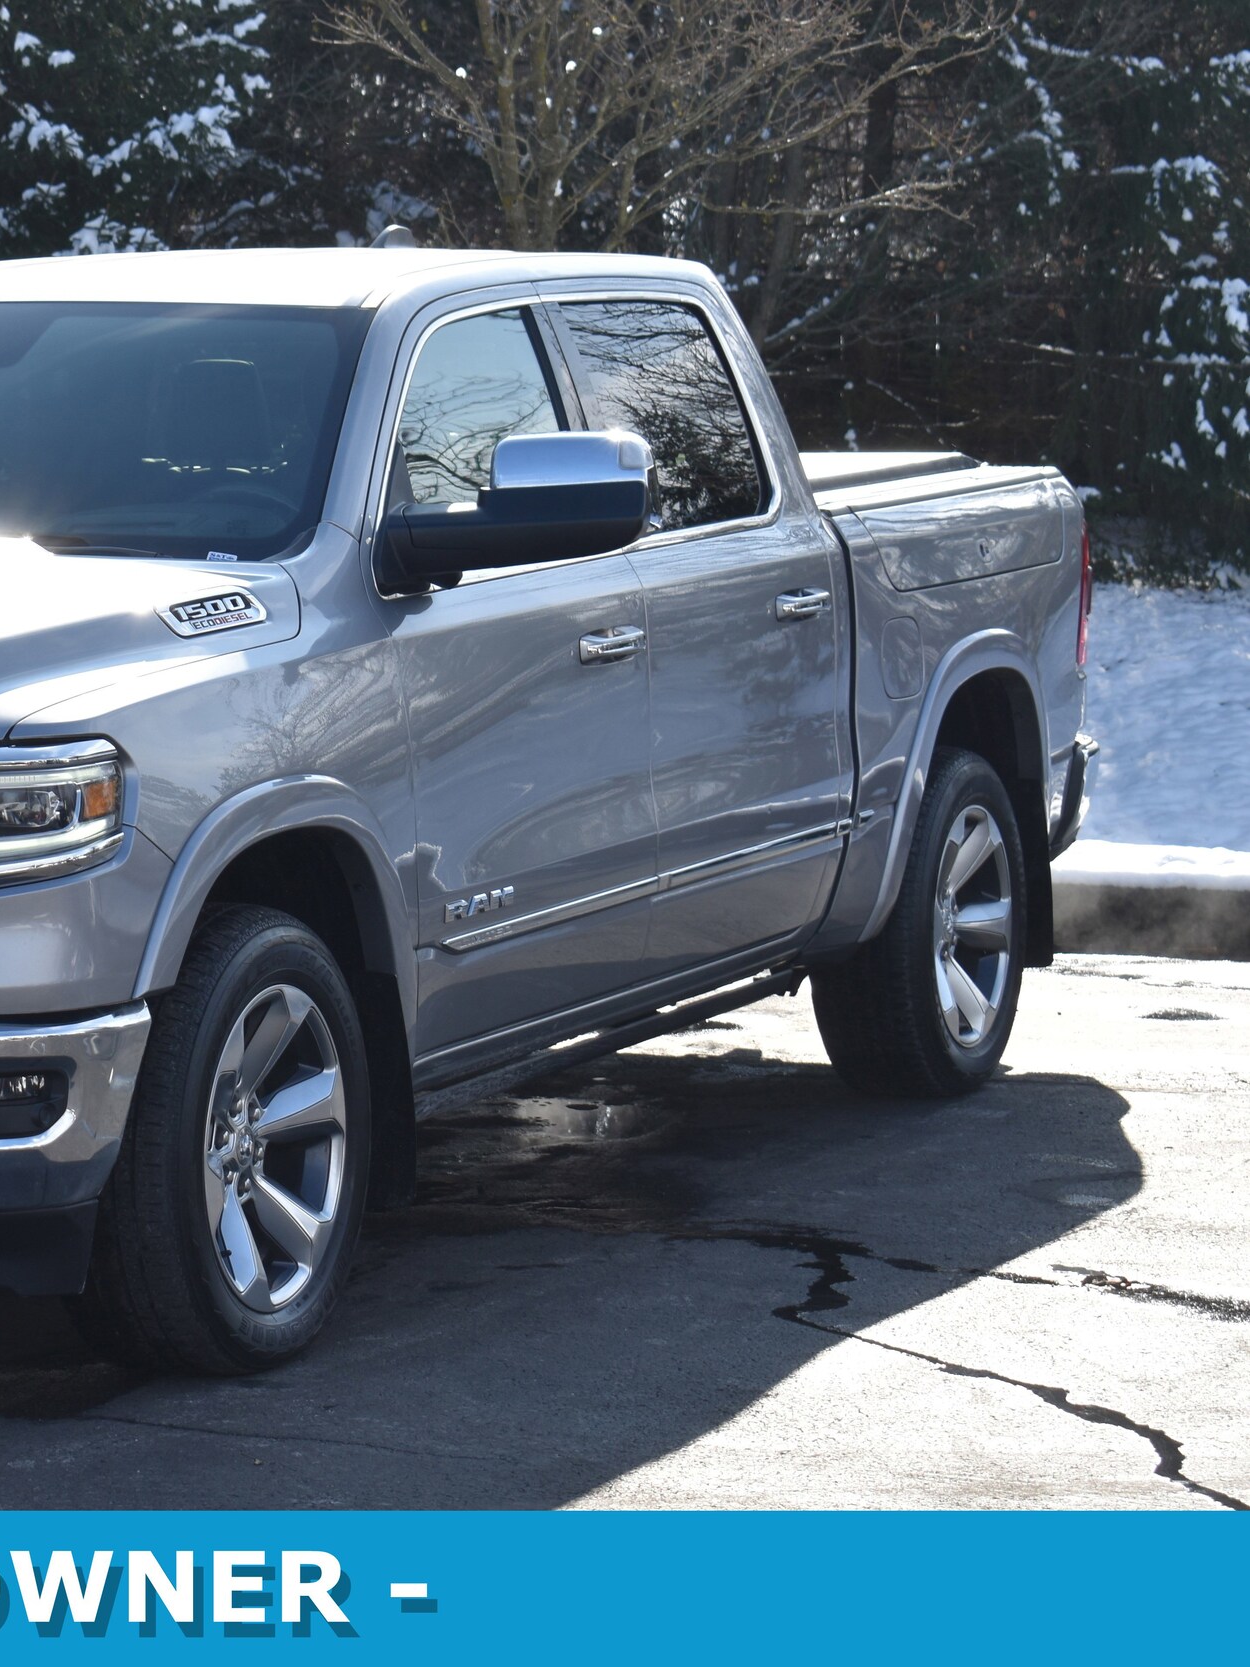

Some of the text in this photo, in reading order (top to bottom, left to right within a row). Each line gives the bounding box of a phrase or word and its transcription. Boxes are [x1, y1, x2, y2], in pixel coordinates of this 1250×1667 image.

[175, 595, 246, 620] 1500
[192, 612, 252, 630] ECODIESEL
[443, 885, 514, 923] RAM
